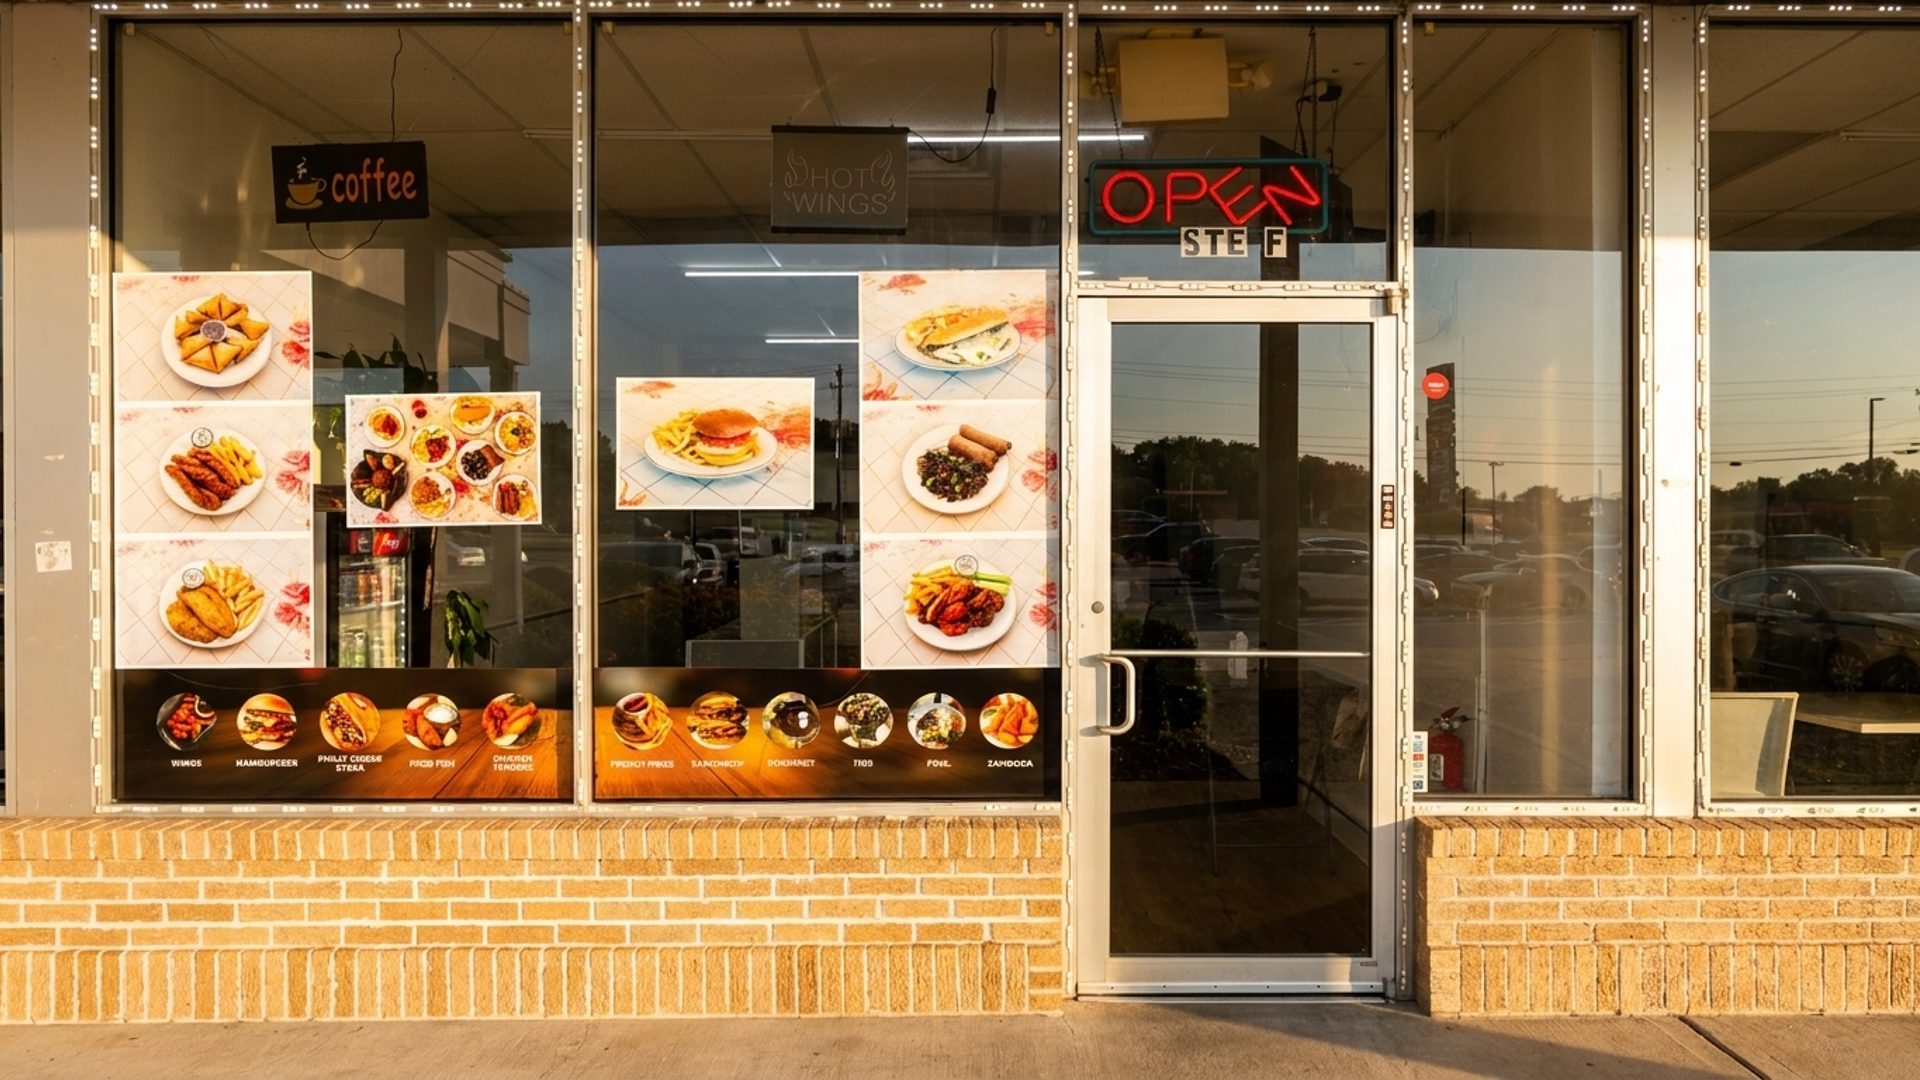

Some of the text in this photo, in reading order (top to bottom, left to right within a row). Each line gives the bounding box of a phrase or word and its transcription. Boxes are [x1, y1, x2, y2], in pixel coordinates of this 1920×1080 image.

[332, 157, 417, 204] coffee
[811, 167, 871, 189] HOT
[791, 192, 888, 215] WINGS
[1101, 165, 1322, 226] OPEN
[1183, 228, 1285, 257] STE F
